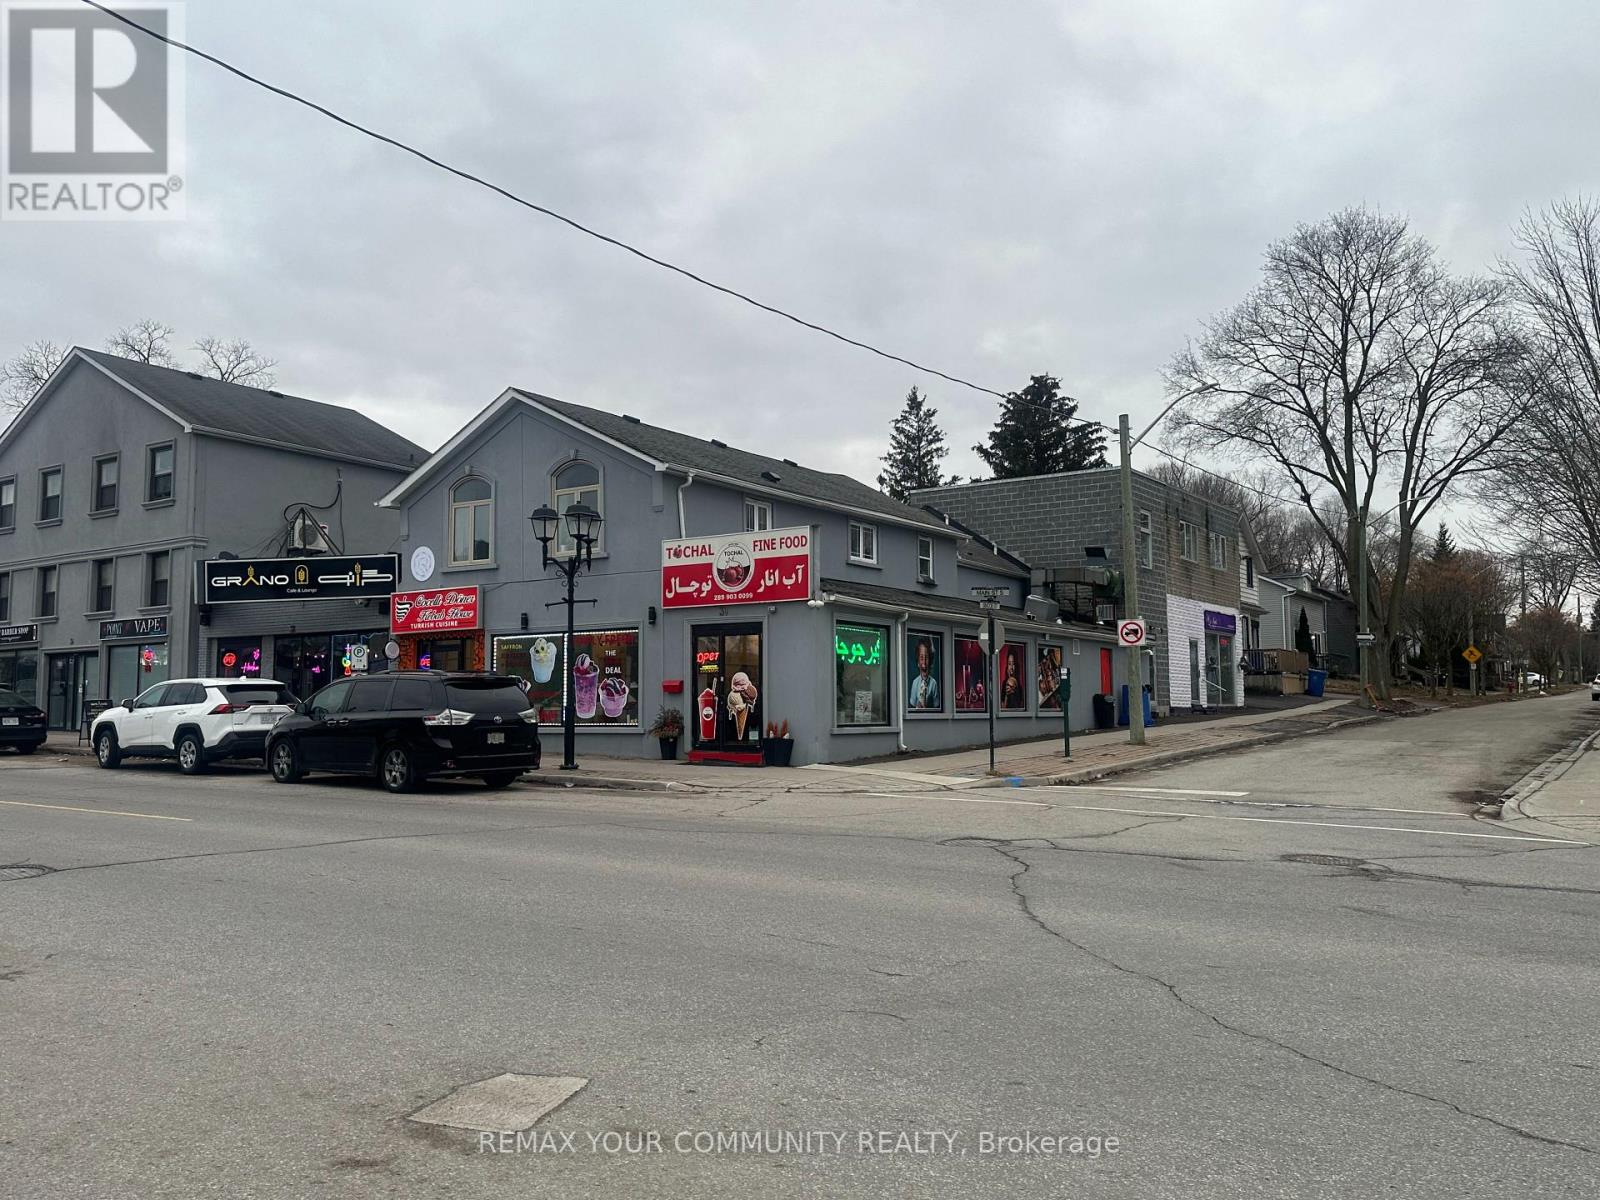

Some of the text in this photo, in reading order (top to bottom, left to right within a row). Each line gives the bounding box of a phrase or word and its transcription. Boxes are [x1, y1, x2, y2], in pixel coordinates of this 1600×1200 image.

[753, 538, 776, 552] FINE
[779, 535, 808, 550] FOOD
[211, 565, 289, 587] GRANO
[757, 564, 805, 593] آب انار
[665, 575, 712, 598] توچال
[134, 618, 161, 633] VAPE
[605, 666, 621, 674] DEAL
